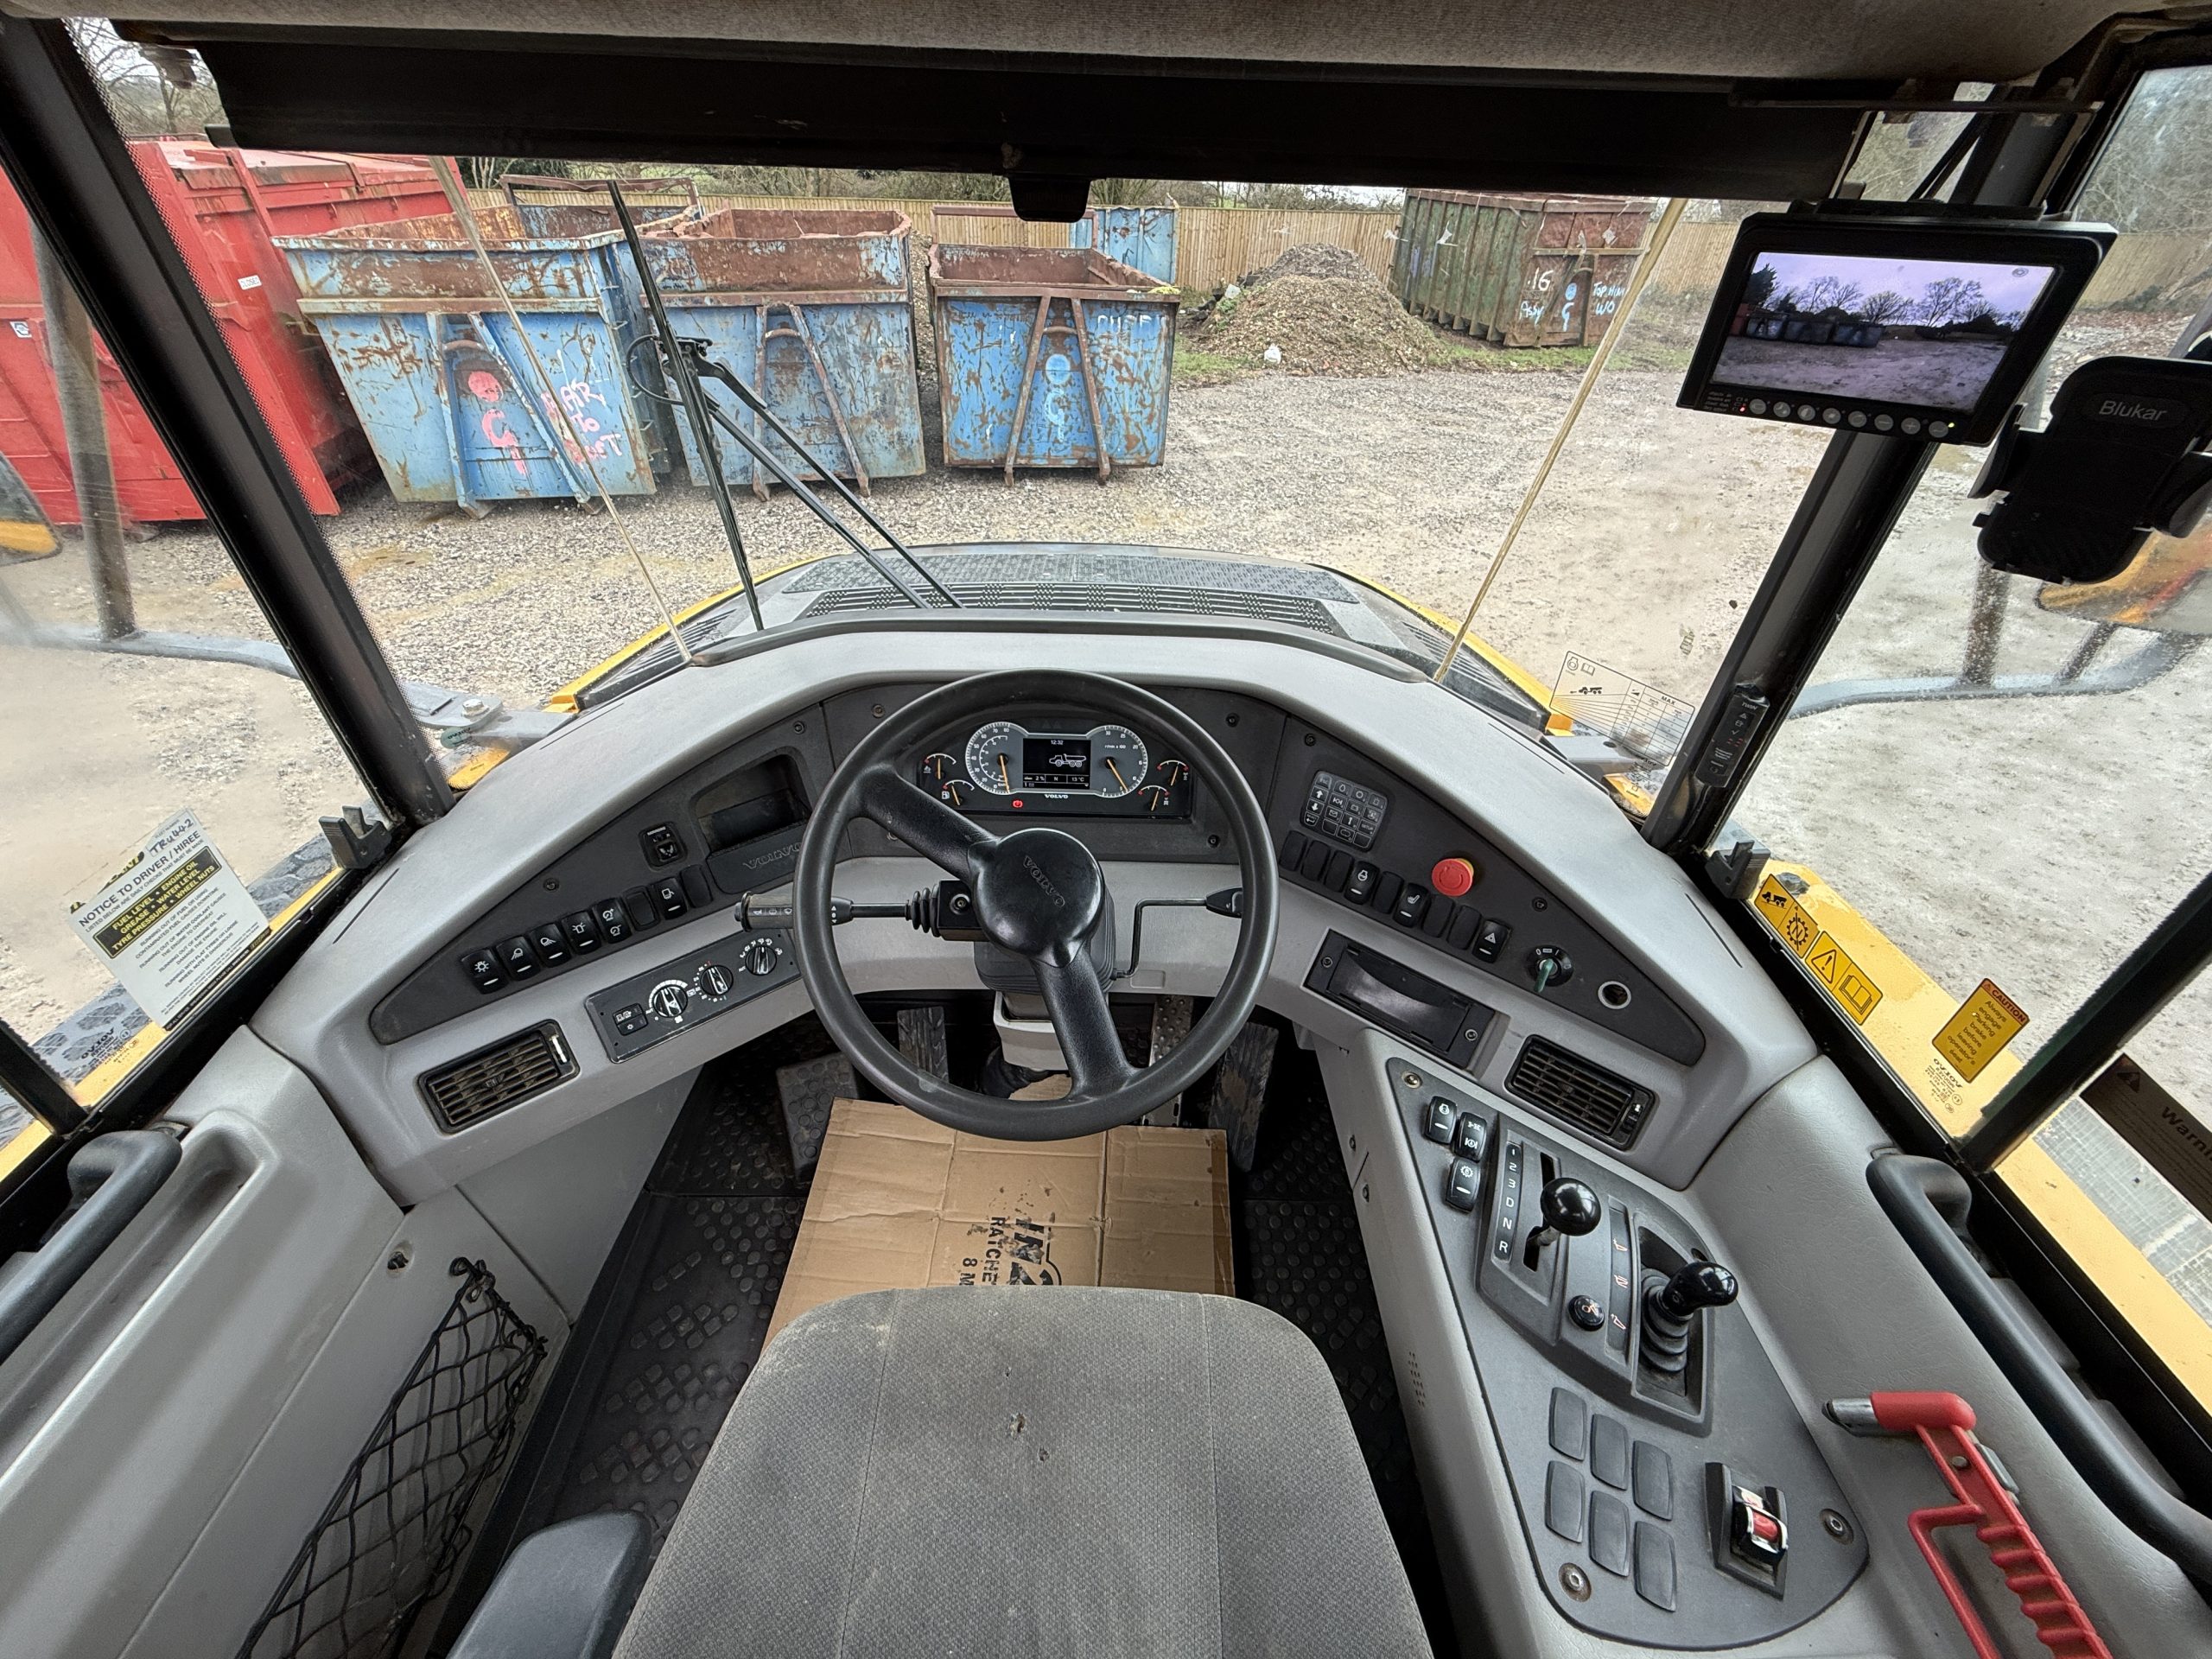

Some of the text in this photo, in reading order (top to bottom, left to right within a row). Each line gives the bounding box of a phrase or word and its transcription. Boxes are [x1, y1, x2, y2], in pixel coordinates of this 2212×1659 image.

[2099, 400, 2167, 421] Blukar
[1661, 696, 1676, 705] MAX
[743, 842, 803, 869] VOLVO
[79, 893, 118, 928] NOTICE
[117, 881, 133, 897] TO
[132, 855, 168, 886] DRIVER
[173, 830, 200, 855] HIREE
[1023, 855, 1065, 907] VOLVO
[111, 912, 133, 931] FUEL
[130, 894, 154, 915] LEVEL
[161, 868, 187, 891] ENGINE
[184, 859, 198, 872] OIL
[119, 868, 200, 934] GREASE WATER LEVEL
[111, 864, 215, 951] TYRE PRESSURE WHEEL NUTS
[175, 922, 191, 937] WATER
[189, 906, 211, 924] COOLANT
[1985, 999, 2007, 1023] Always
[1991, 988, 2025, 1022] CAUTION
[1969, 1021, 1987, 1039] brake
[1973, 1012, 1995, 1037] Parking
[1978, 1007, 2002, 1030] engage
[1956, 1032, 1977, 1055] leaving
[1962, 1027, 1982, 1047] before
[1946, 1034, 1977, 1065] operator's
[1509, 1162, 1517, 1172] 2
[1508, 1179, 1516, 1189] 3
[1505, 1197, 1515, 1208] D
[1503, 1217, 1512, 1230] N
[1498, 1240, 1509, 1253] R
[963, 1257, 978, 1267] 8
